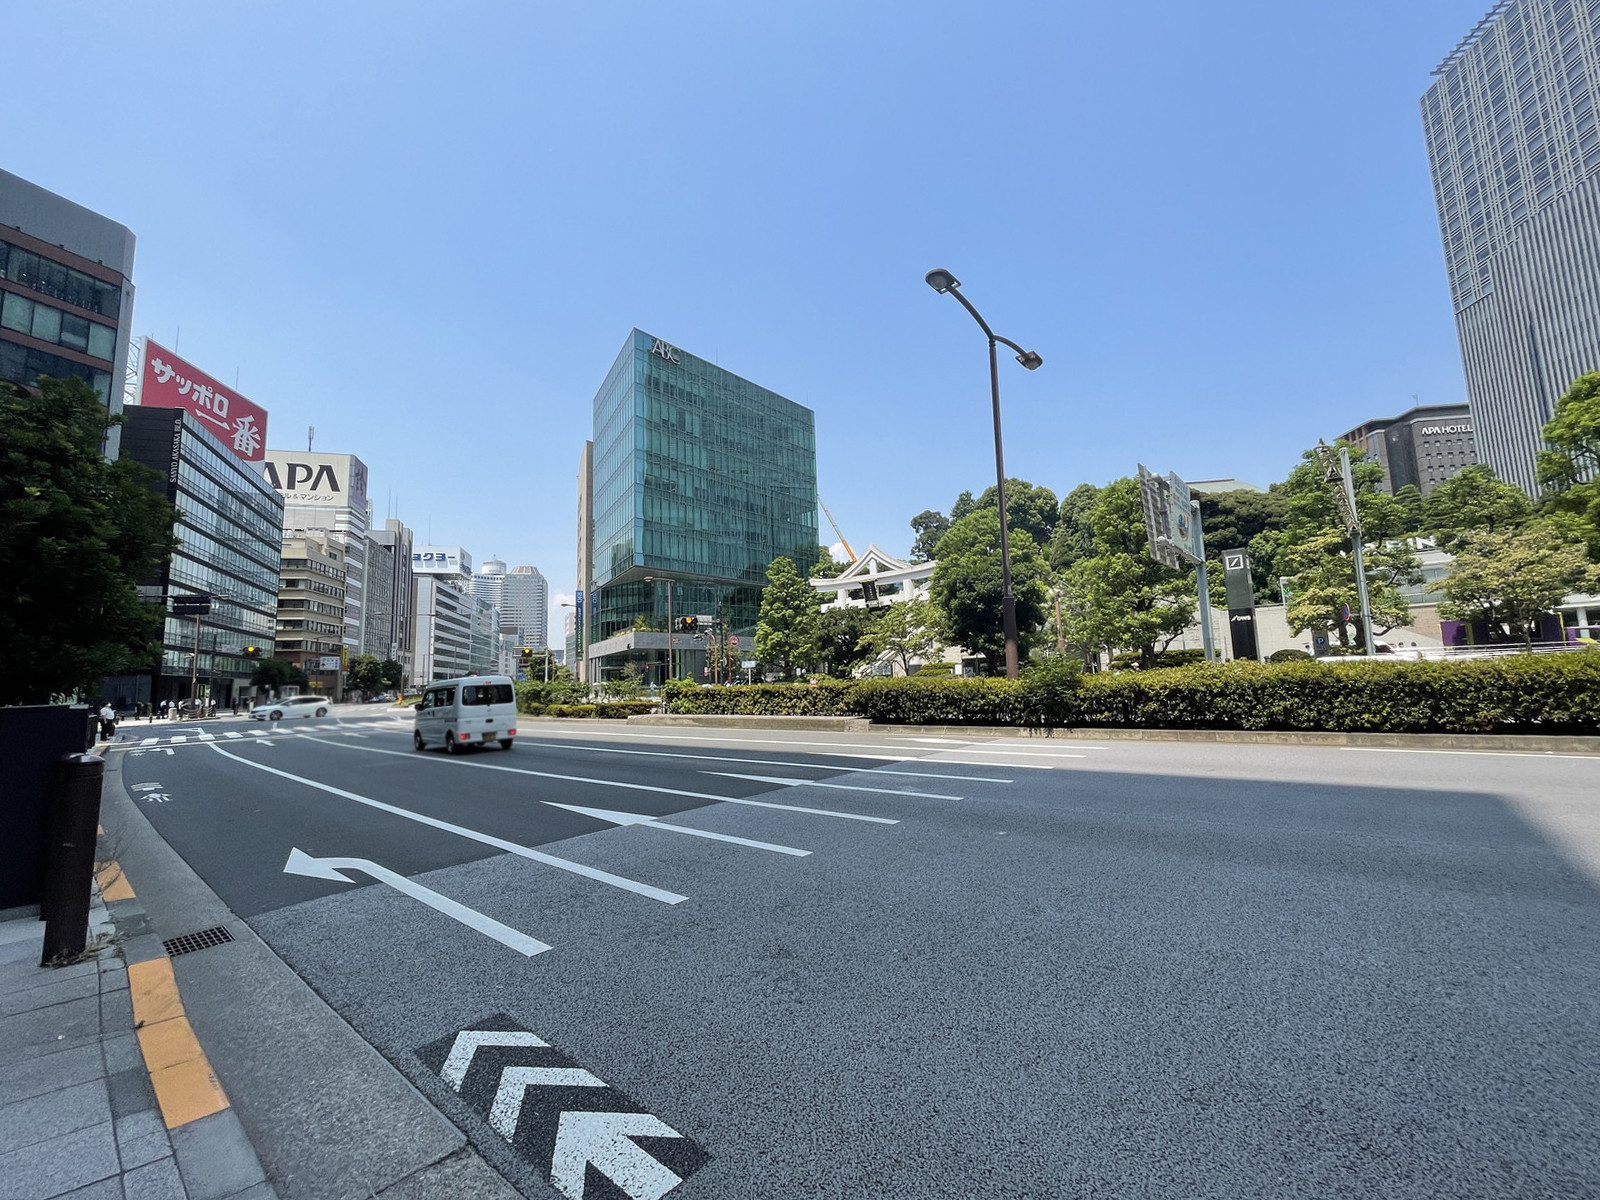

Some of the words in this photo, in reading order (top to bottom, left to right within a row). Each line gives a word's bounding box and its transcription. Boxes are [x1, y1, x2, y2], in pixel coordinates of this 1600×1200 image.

[151, 358, 229, 419] サッポロ
[195, 408, 261, 457] 一番
[1421, 427, 1441, 435] APA
[1441, 424, 1474, 434] HOTEL
[172, 433, 180, 461] AKASAKA
[265, 461, 341, 492] APA
